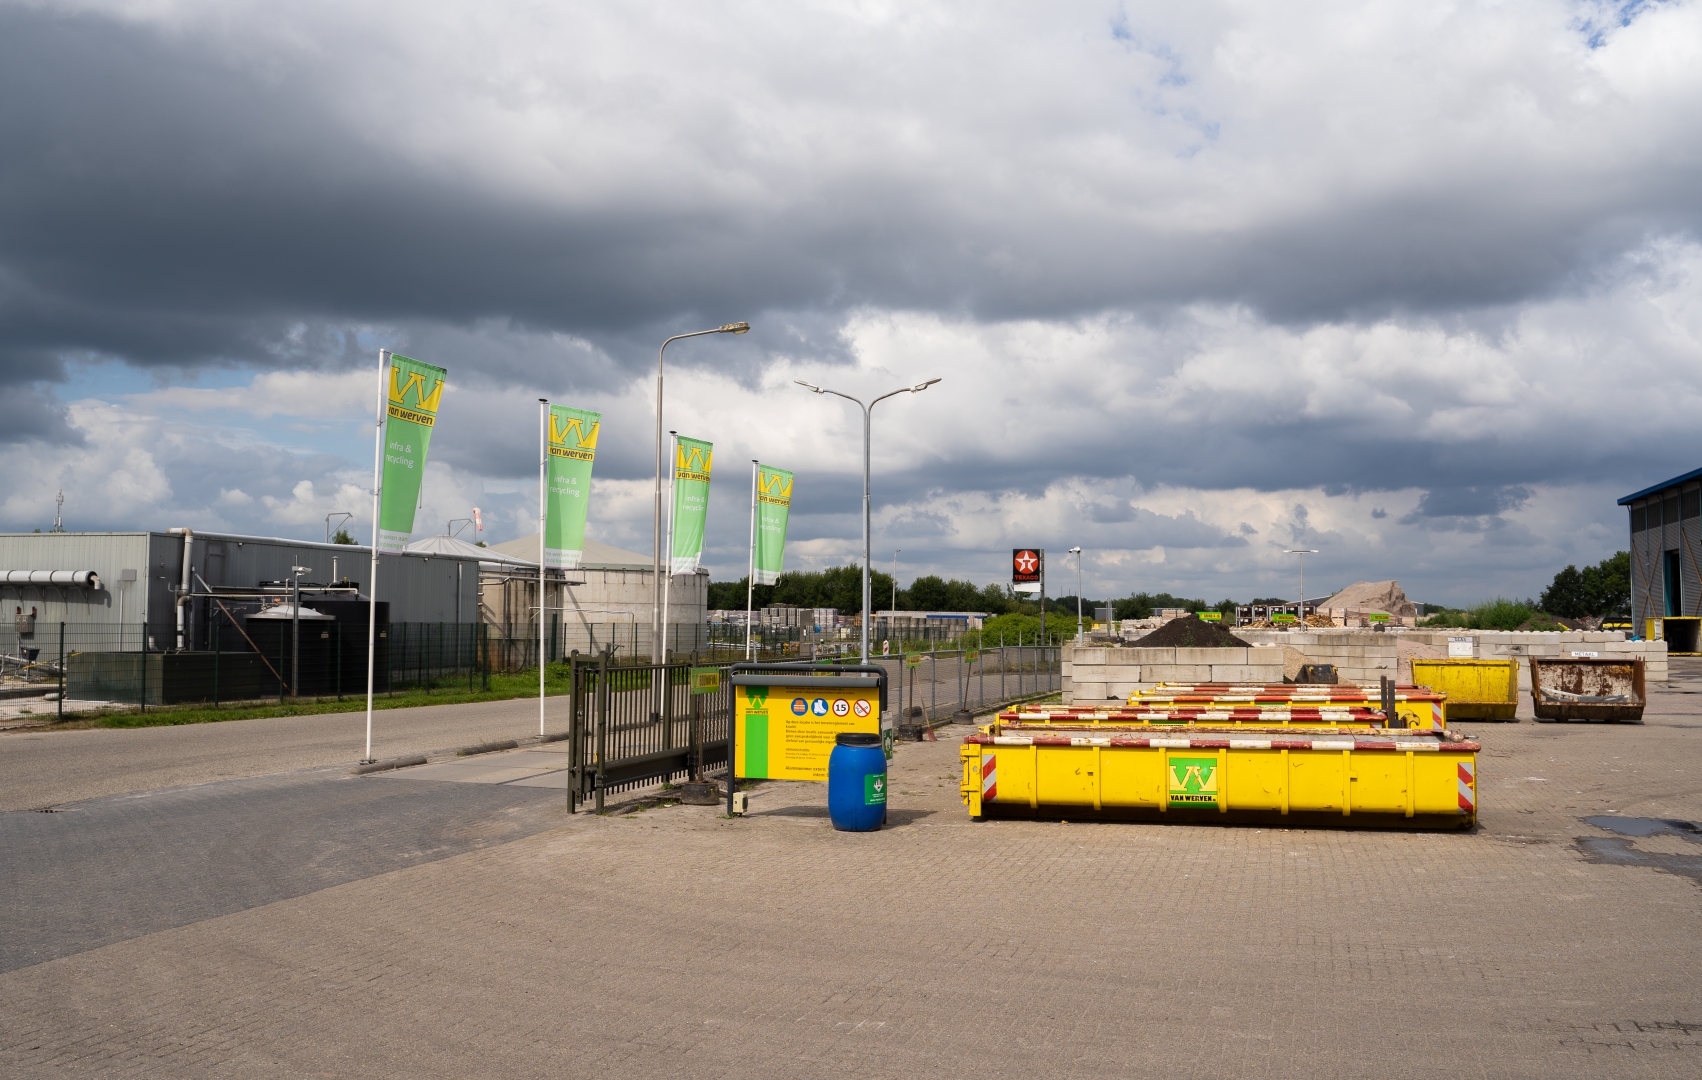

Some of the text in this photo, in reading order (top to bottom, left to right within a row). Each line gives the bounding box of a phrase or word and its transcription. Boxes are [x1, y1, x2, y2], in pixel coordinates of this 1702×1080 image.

[400, 409, 433, 425] werven
[389, 440, 412, 453] infra &
[562, 449, 593, 460] werven
[385, 453, 414, 469] recycling
[553, 475, 577, 485] infra &
[549, 486, 580, 498] recycling
[835, 704, 847, 712] 15
